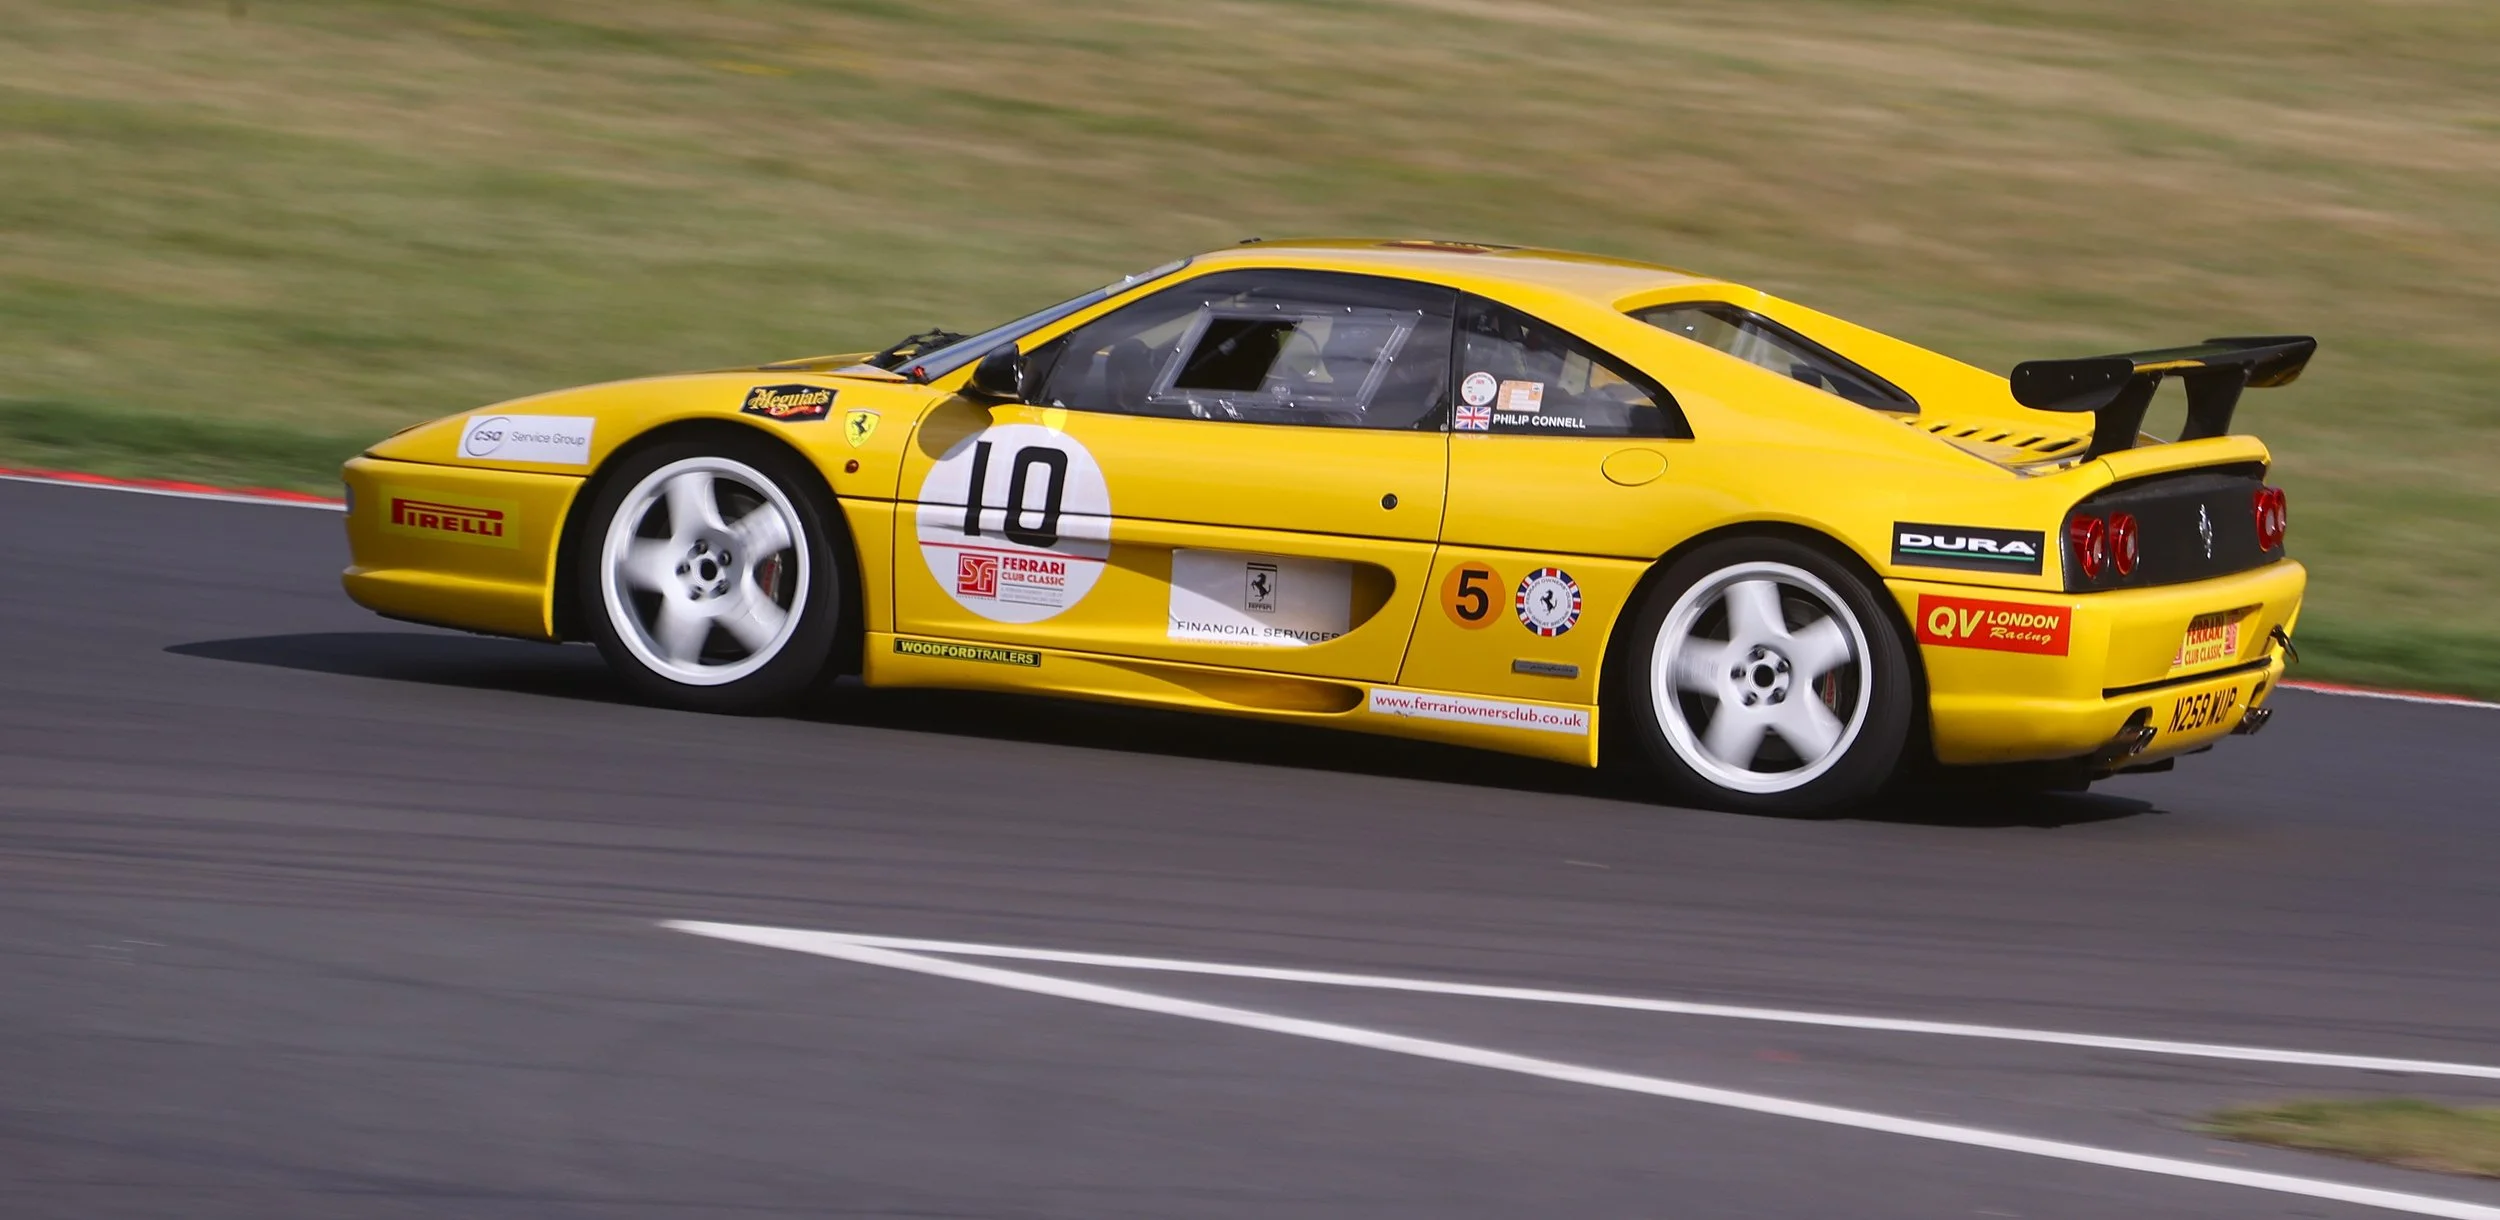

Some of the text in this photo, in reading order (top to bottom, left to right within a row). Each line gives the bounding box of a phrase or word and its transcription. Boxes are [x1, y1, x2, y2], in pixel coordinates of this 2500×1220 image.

[748, 388, 830, 412] Meguiar's
[1493, 414, 1586, 429] PHILIP CONNELL
[511, 431, 550, 443] Service
[553, 433, 585, 446] Group
[964, 440, 1069, 547] 10
[391, 498, 504, 537] PIRELLI
[1900, 533, 2035, 555] DURA
[1003, 557, 1065, 575] FERRARI
[1001, 572, 1065, 586] CLUB CLASSIC
[1455, 569, 1489, 621] 5
[1177, 621, 1259, 637] FINANCIAL
[1928, 606, 2059, 639] QV LONDON
[1990, 627, 2051, 645] Racing
[2185, 643, 2222, 666] CLUB CLASSIC
[1375, 696, 1582, 727] www.ferrariownersclub.co.uk
[2167, 687, 2238, 734] N258 WUP
